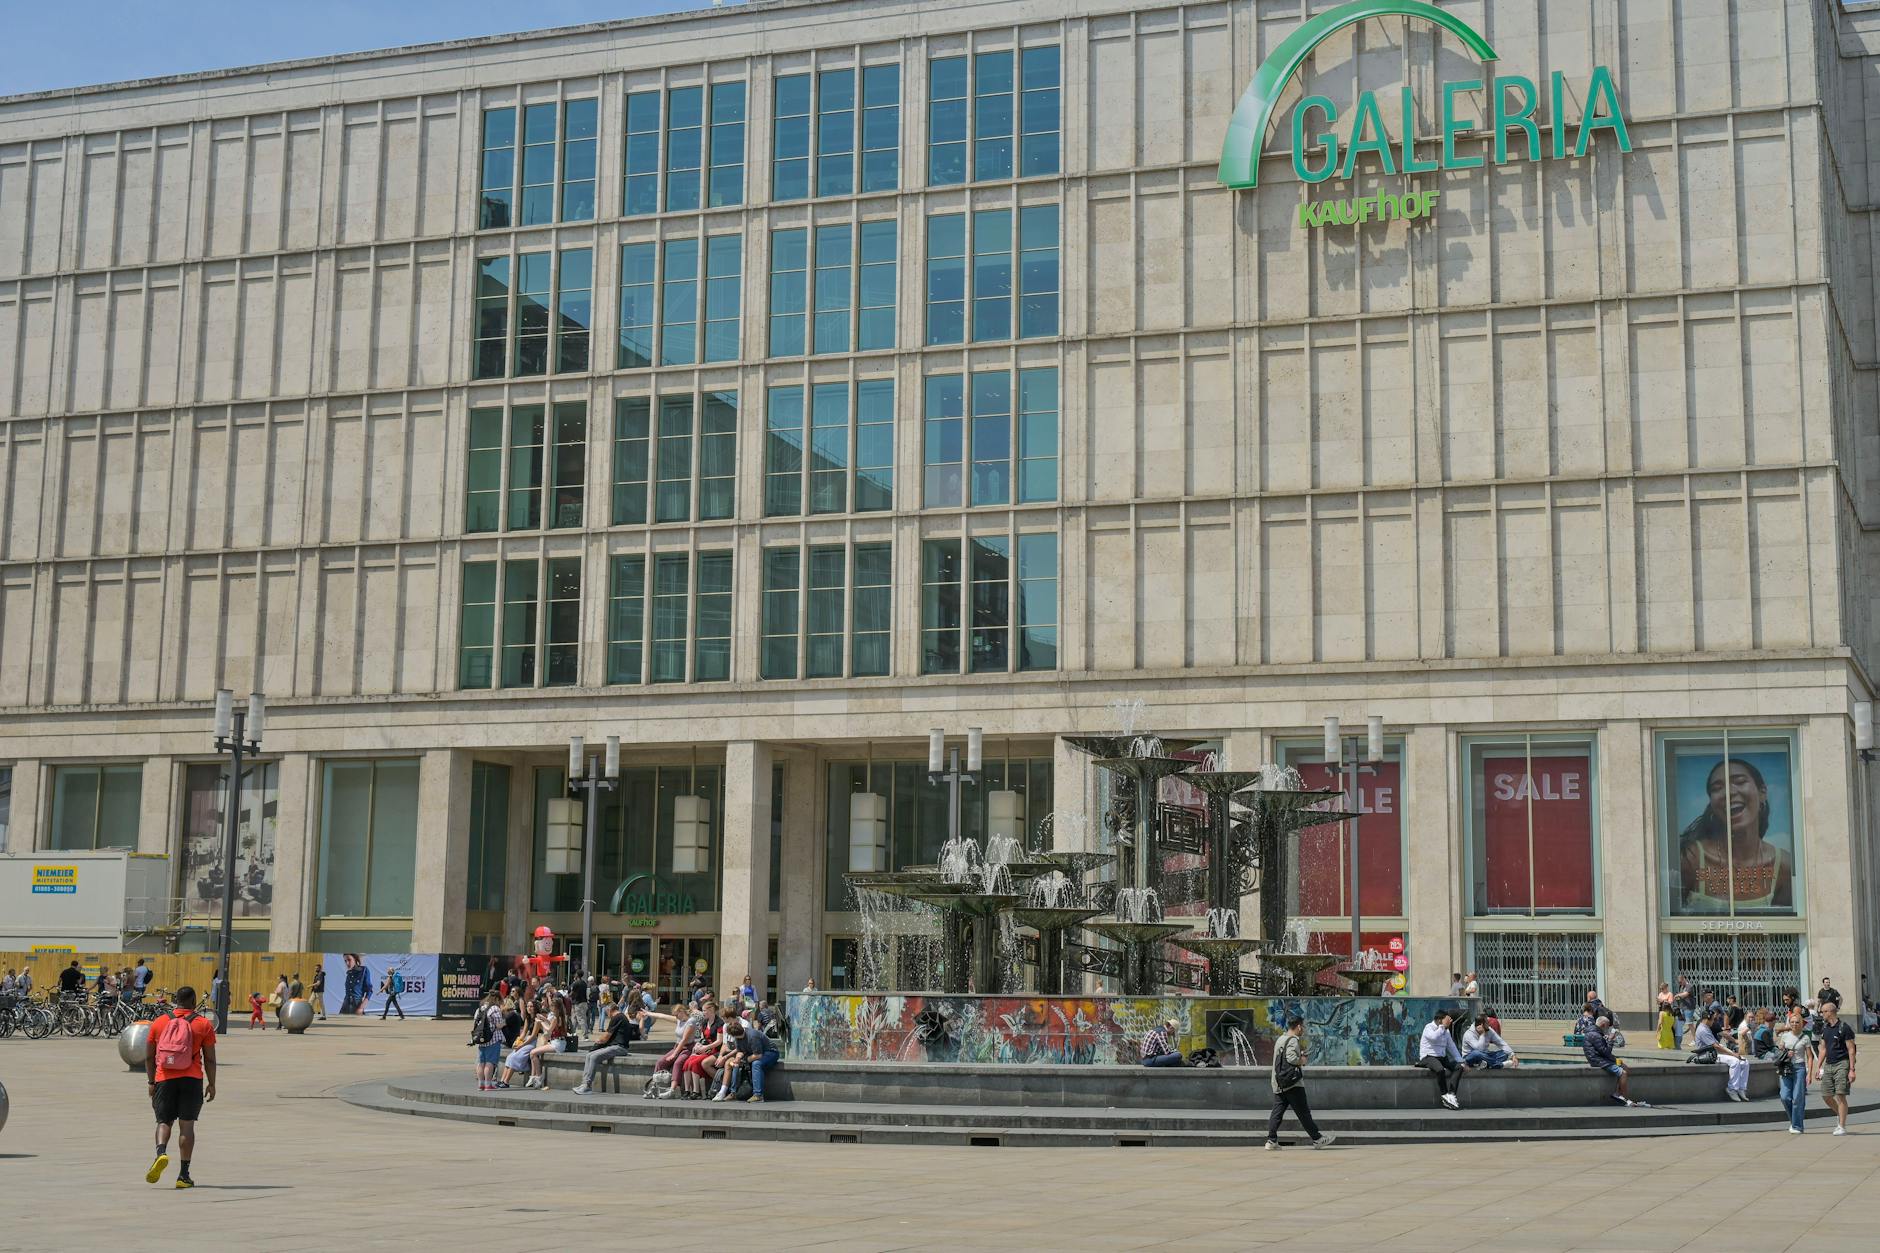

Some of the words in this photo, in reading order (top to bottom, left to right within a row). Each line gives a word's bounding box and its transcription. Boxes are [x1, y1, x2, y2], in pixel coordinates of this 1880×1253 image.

[1290, 65, 1632, 184] GALERIA
[1494, 773, 1580, 800] SALE
[37, 869, 74, 877] NIEMEIER
[625, 893, 696, 915] GALERIA
[1702, 920, 1764, 929] SEPHORA
[442, 974, 457, 985] WIR
[457, 974, 481, 986] HABEN
[441, 985, 480, 998] GEÖFFNET!
